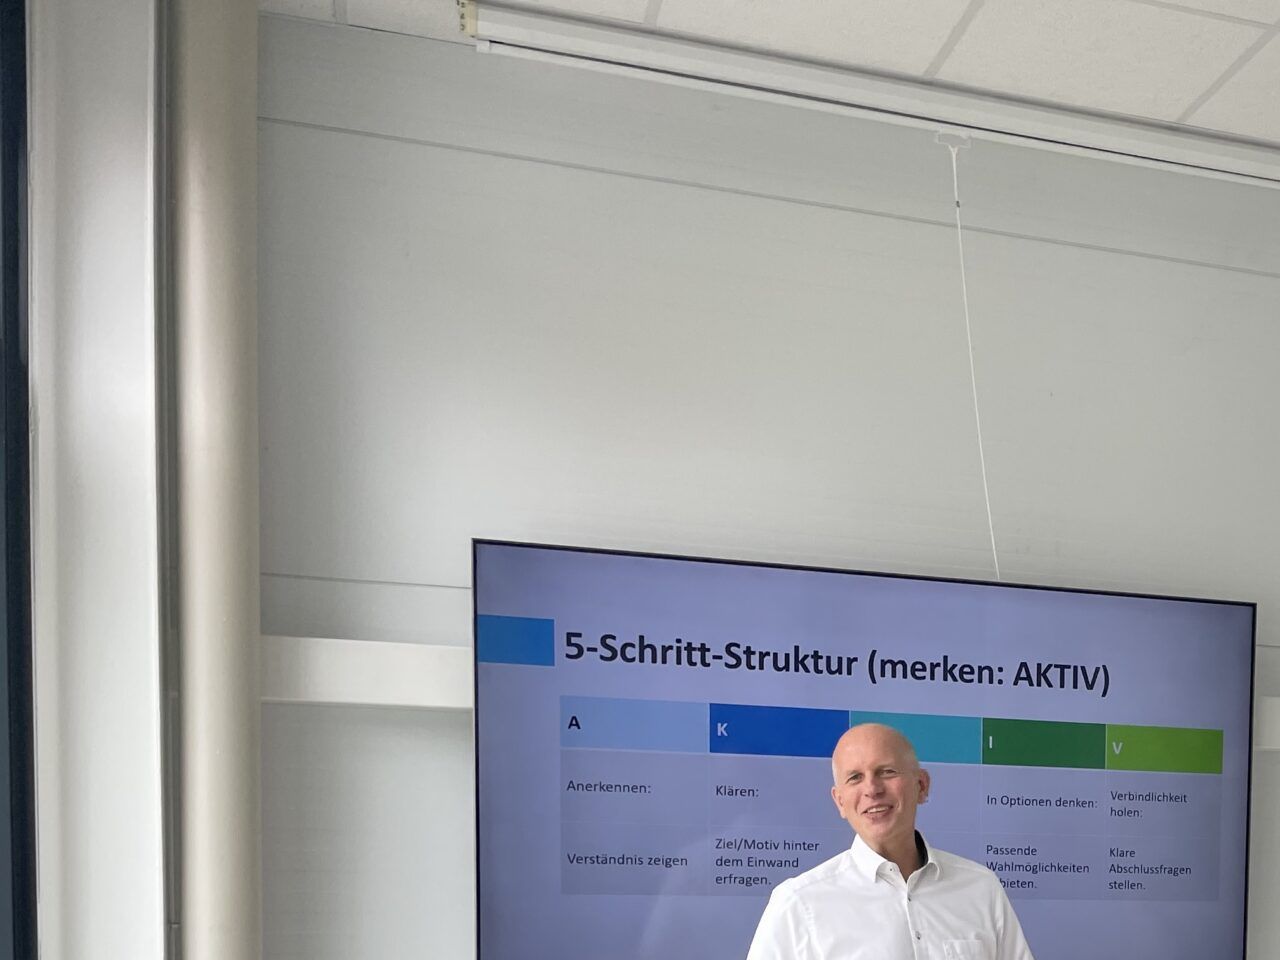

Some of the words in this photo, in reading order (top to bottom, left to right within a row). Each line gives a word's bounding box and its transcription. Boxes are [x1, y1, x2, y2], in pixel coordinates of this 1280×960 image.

[565, 631, 858, 677] 5-Schritt-Struktur
[868, 649, 1004, 686] (merken:
[1012, 660, 1111, 698] AKTIV)
[567, 715, 581, 730] A
[716, 722, 729, 737] K
[1112, 742, 1123, 755] V
[566, 780, 652, 795] Anerkennen:
[715, 784, 760, 799] Klären:
[986, 795, 998, 806] In
[1000, 795, 1052, 809] Optionen
[1055, 796, 1098, 809] denken:
[1110, 790, 1188, 804] Verbindlichkeit
[715, 838, 780, 853] Ziel/Motiv
[783, 839, 820, 852] hinter
[986, 845, 1038, 857] Passende
[567, 853, 644, 867] Verständnis
[647, 855, 688, 868] zeigen
[1109, 848, 1136, 859] Klare
[715, 856, 744, 868] dem
[747, 856, 799, 869] Einwand
[986, 861, 1089, 875] Wahlmöglichkeiten
[1109, 864, 1192, 877] Abschlussfragen
[715, 873, 772, 887] erfragen.
[1108, 879, 1146, 891] stellen.
